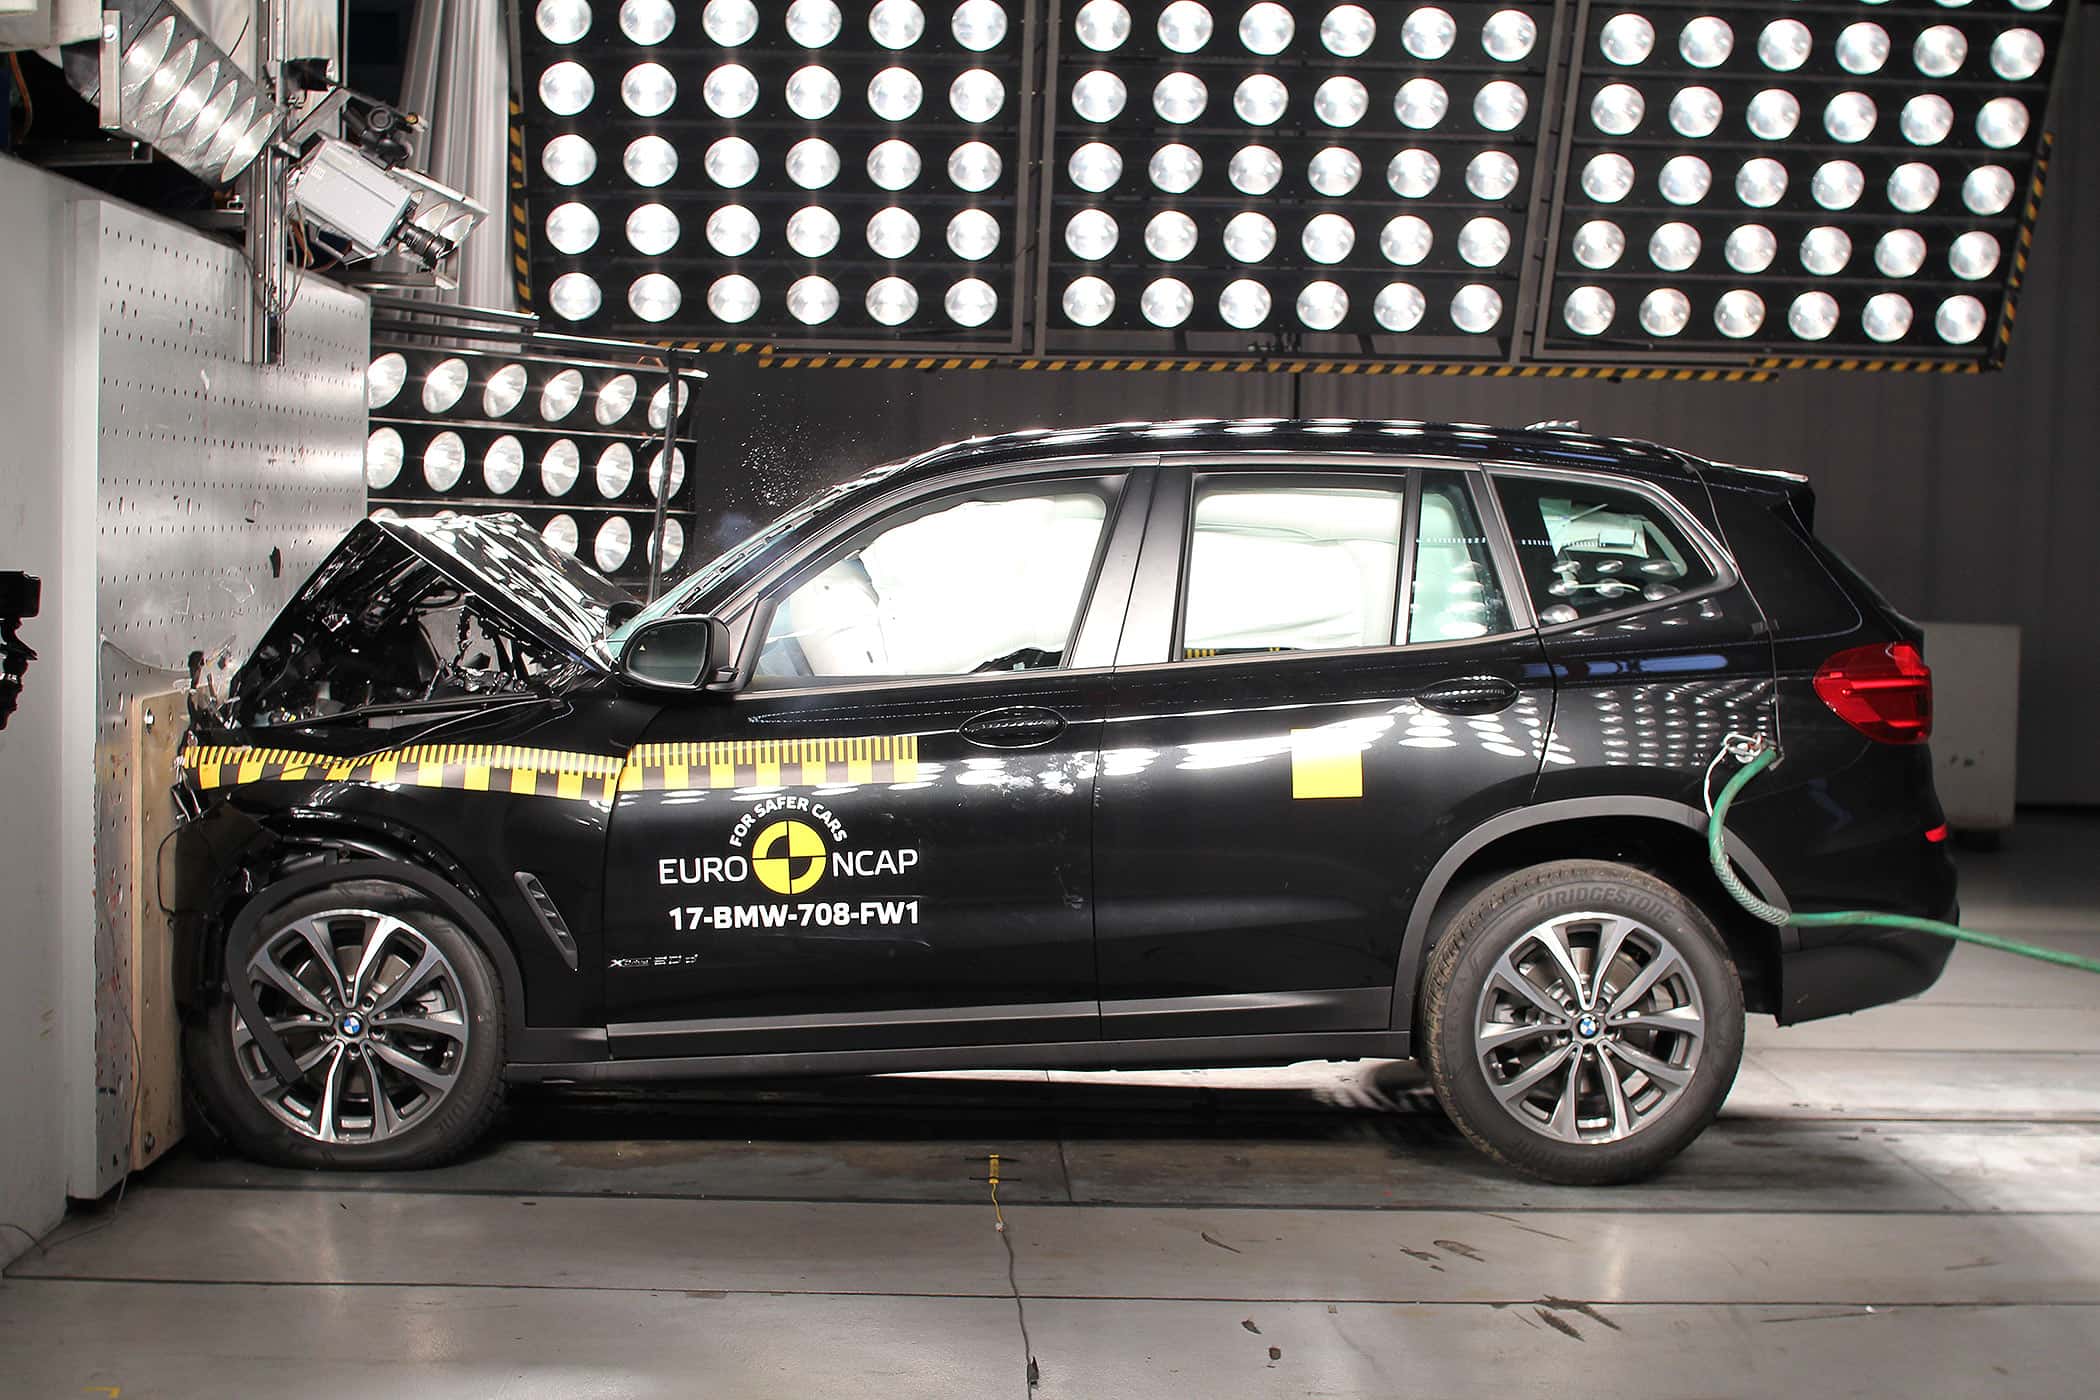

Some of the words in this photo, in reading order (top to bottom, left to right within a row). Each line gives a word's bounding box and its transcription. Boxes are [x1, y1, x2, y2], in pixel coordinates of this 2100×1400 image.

[729, 813, 757, 848] FOR
[753, 795, 809, 819] SAFER
[811, 803, 848, 842] CARS
[658, 855, 749, 885] EURO
[831, 848, 919, 878] NCAP
[668, 900, 920, 931] 17-BMW-708-FW1
